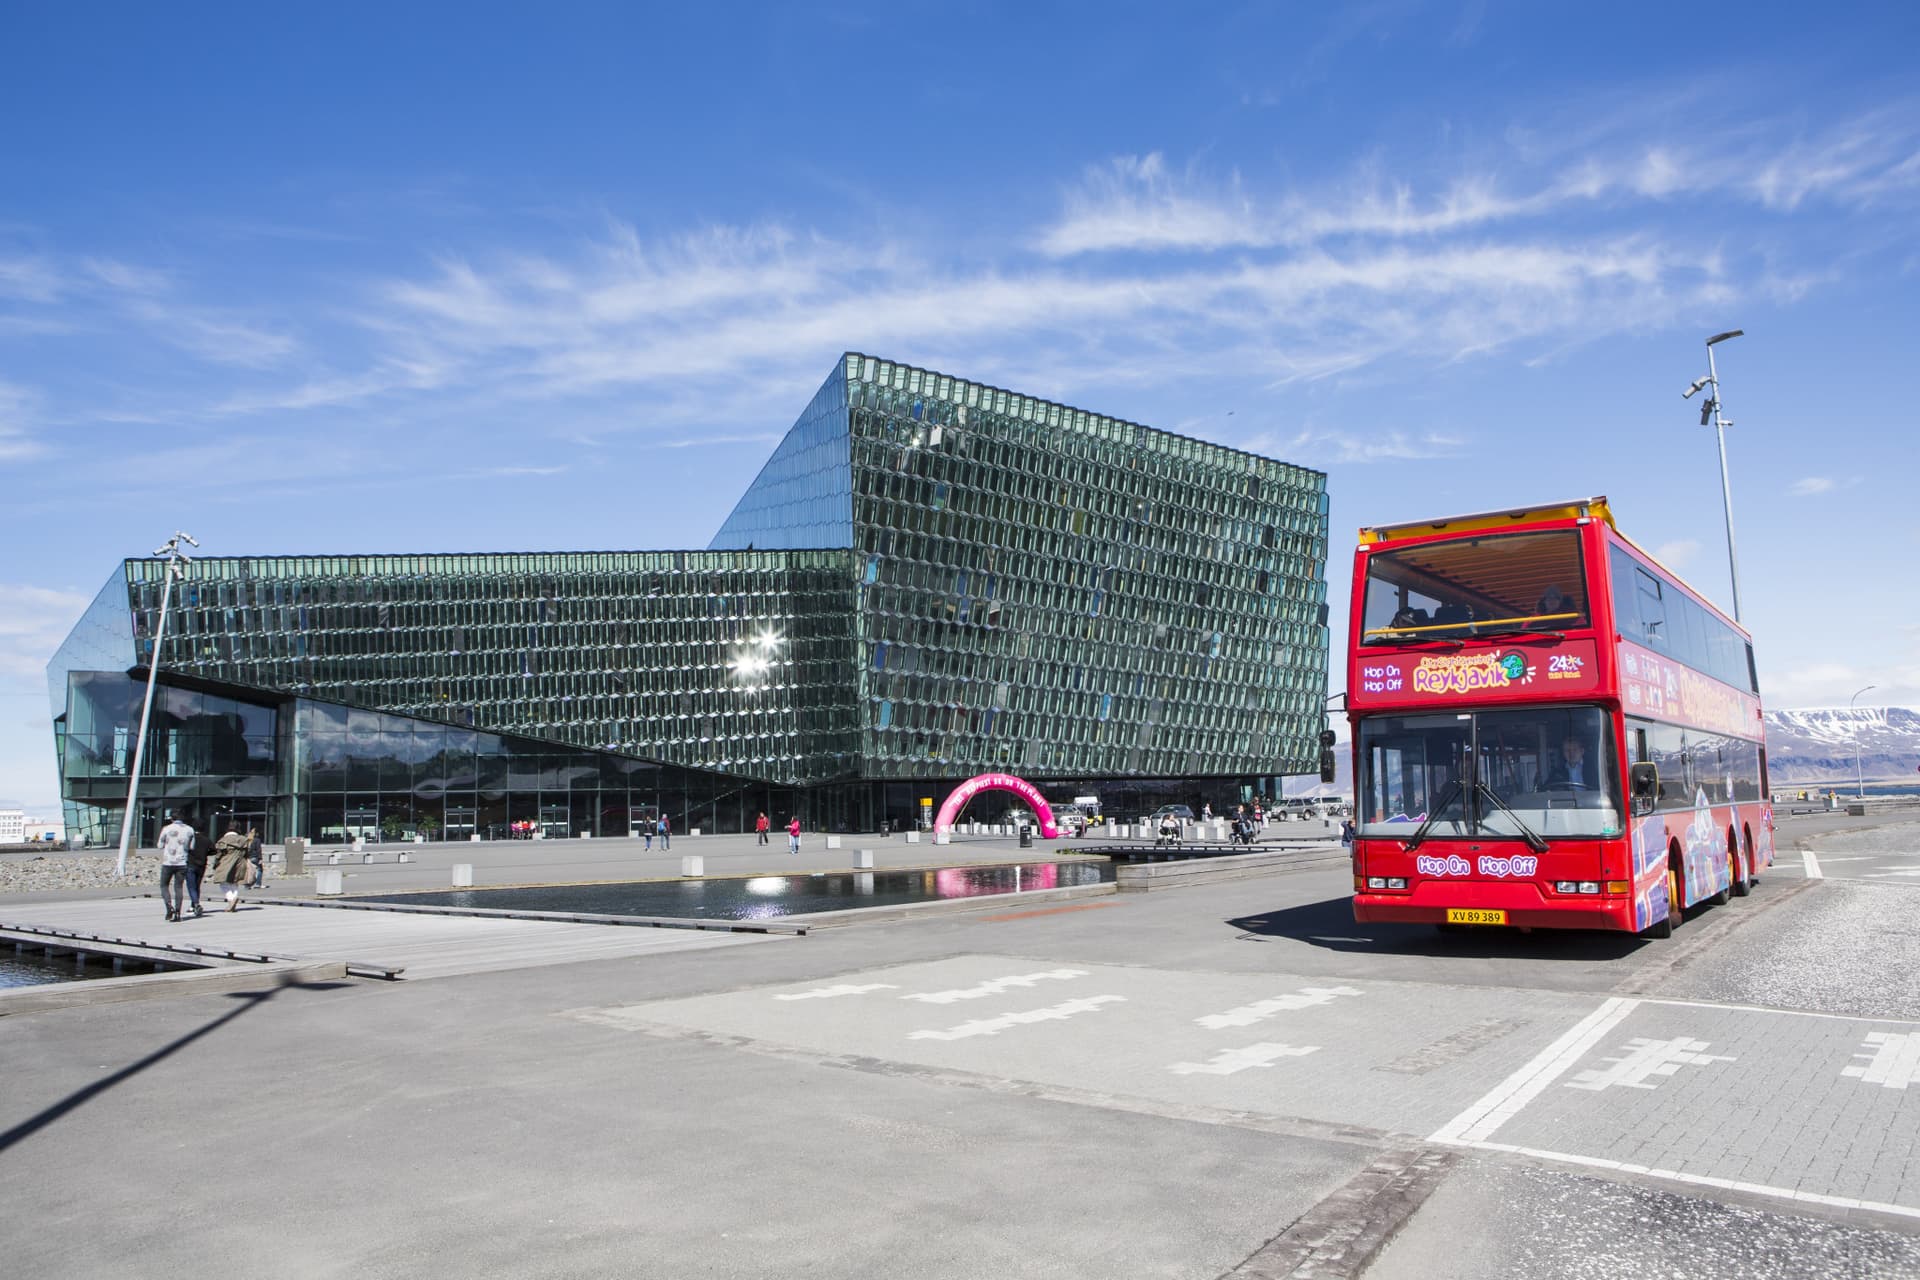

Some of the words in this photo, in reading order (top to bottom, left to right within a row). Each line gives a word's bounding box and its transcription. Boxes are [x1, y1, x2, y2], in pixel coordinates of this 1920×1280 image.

[1364, 666, 1384, 678] Hop
[1386, 664, 1400, 677] On
[1364, 680, 1384, 692] Hop
[1386, 678, 1402, 691] Off
[1417, 855, 1447, 877] Hop
[1448, 855, 1471, 876] On
[1478, 855, 1510, 877] Hop
[1510, 855, 1537, 877] Off
[1452, 911, 1466, 921] XV
[1467, 911, 1480, 921] 89
[1482, 912, 1501, 922] 389
